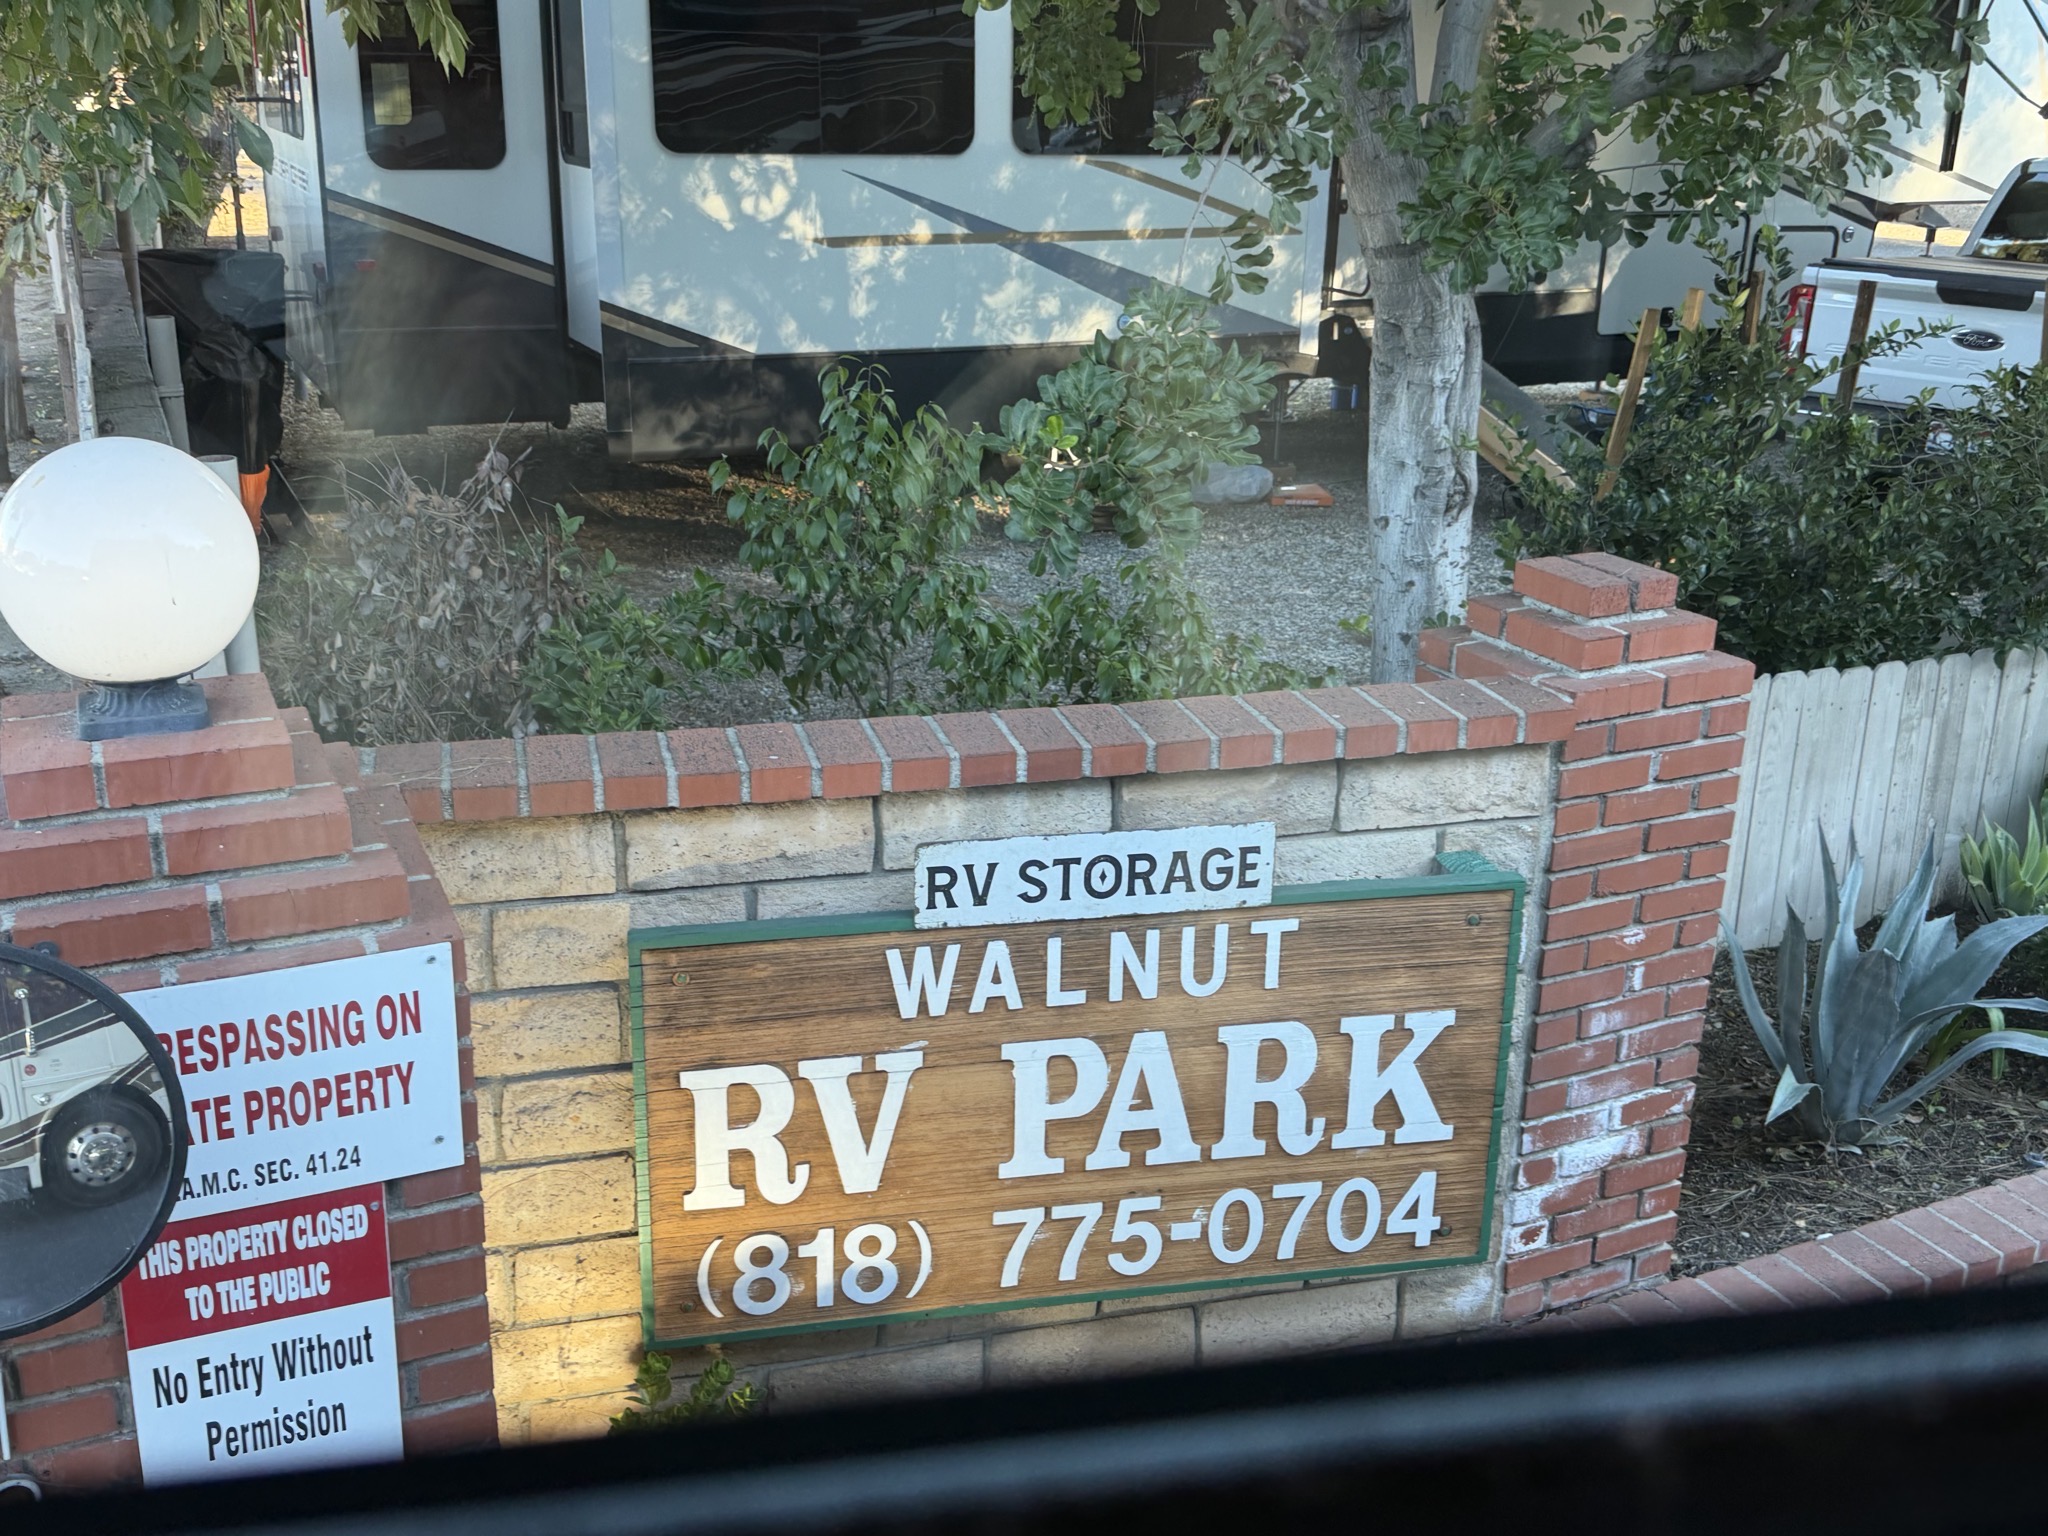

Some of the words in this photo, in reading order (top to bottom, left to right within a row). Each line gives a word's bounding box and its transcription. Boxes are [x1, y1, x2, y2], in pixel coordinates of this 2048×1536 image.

[925, 862, 998, 910] RV
[1018, 846, 1263, 903] STORAGE
[885, 918, 1300, 1019] WALNUT
[376, 990, 422, 1041] ON
[243, 1061, 415, 1136] PROPERTY
[679, 1050, 924, 1212] RV
[998, 1009, 1456, 1179] PARK
[254, 1158, 300, 1187] SEC.
[306, 1145, 362, 1176] 41.24
[184, 1219, 289, 1271] PROPERTY
[291, 1204, 369, 1248] CLOSED
[697, 1219, 933, 1318] (818)
[992, 1171, 1441, 1288] 775-0704
[184, 1284, 215, 1321] TO
[216, 1276, 258, 1315] THE
[258, 1261, 331, 1307] PUBLIC
[152, 1365, 188, 1409] No
[196, 1353, 265, 1399] Entry
[271, 1325, 374, 1382] Without
[205, 1399, 347, 1462] Permission
